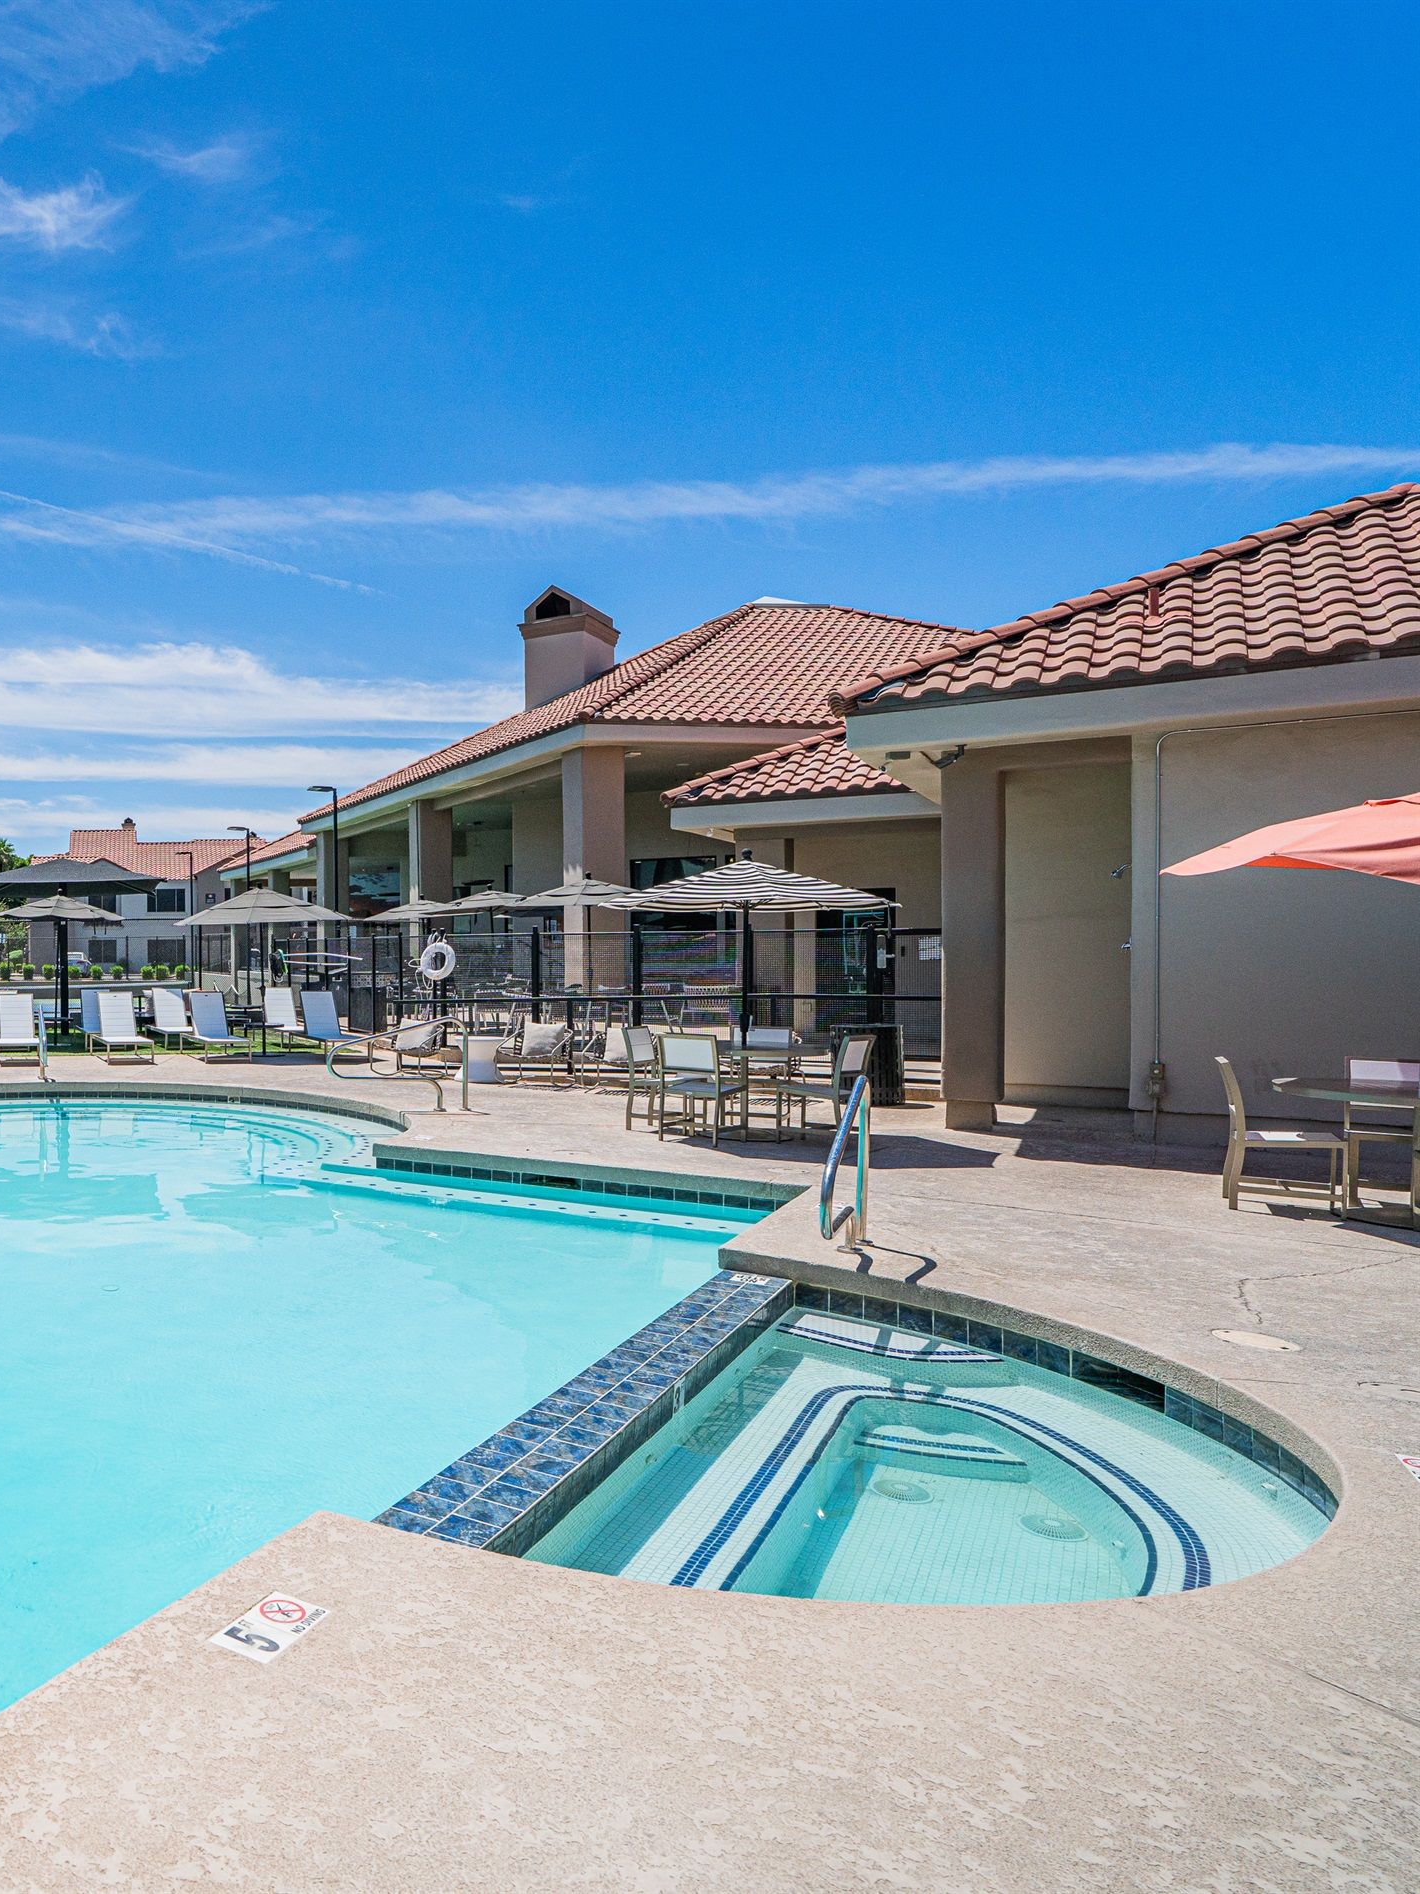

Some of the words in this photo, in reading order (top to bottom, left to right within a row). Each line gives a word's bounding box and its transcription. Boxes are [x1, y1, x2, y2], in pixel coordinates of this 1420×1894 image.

[238, 1619, 254, 1629] FT
[290, 1625, 306, 1635] NO
[300, 1608, 326, 1626] DIVING
[223, 1626, 280, 1652] 5
